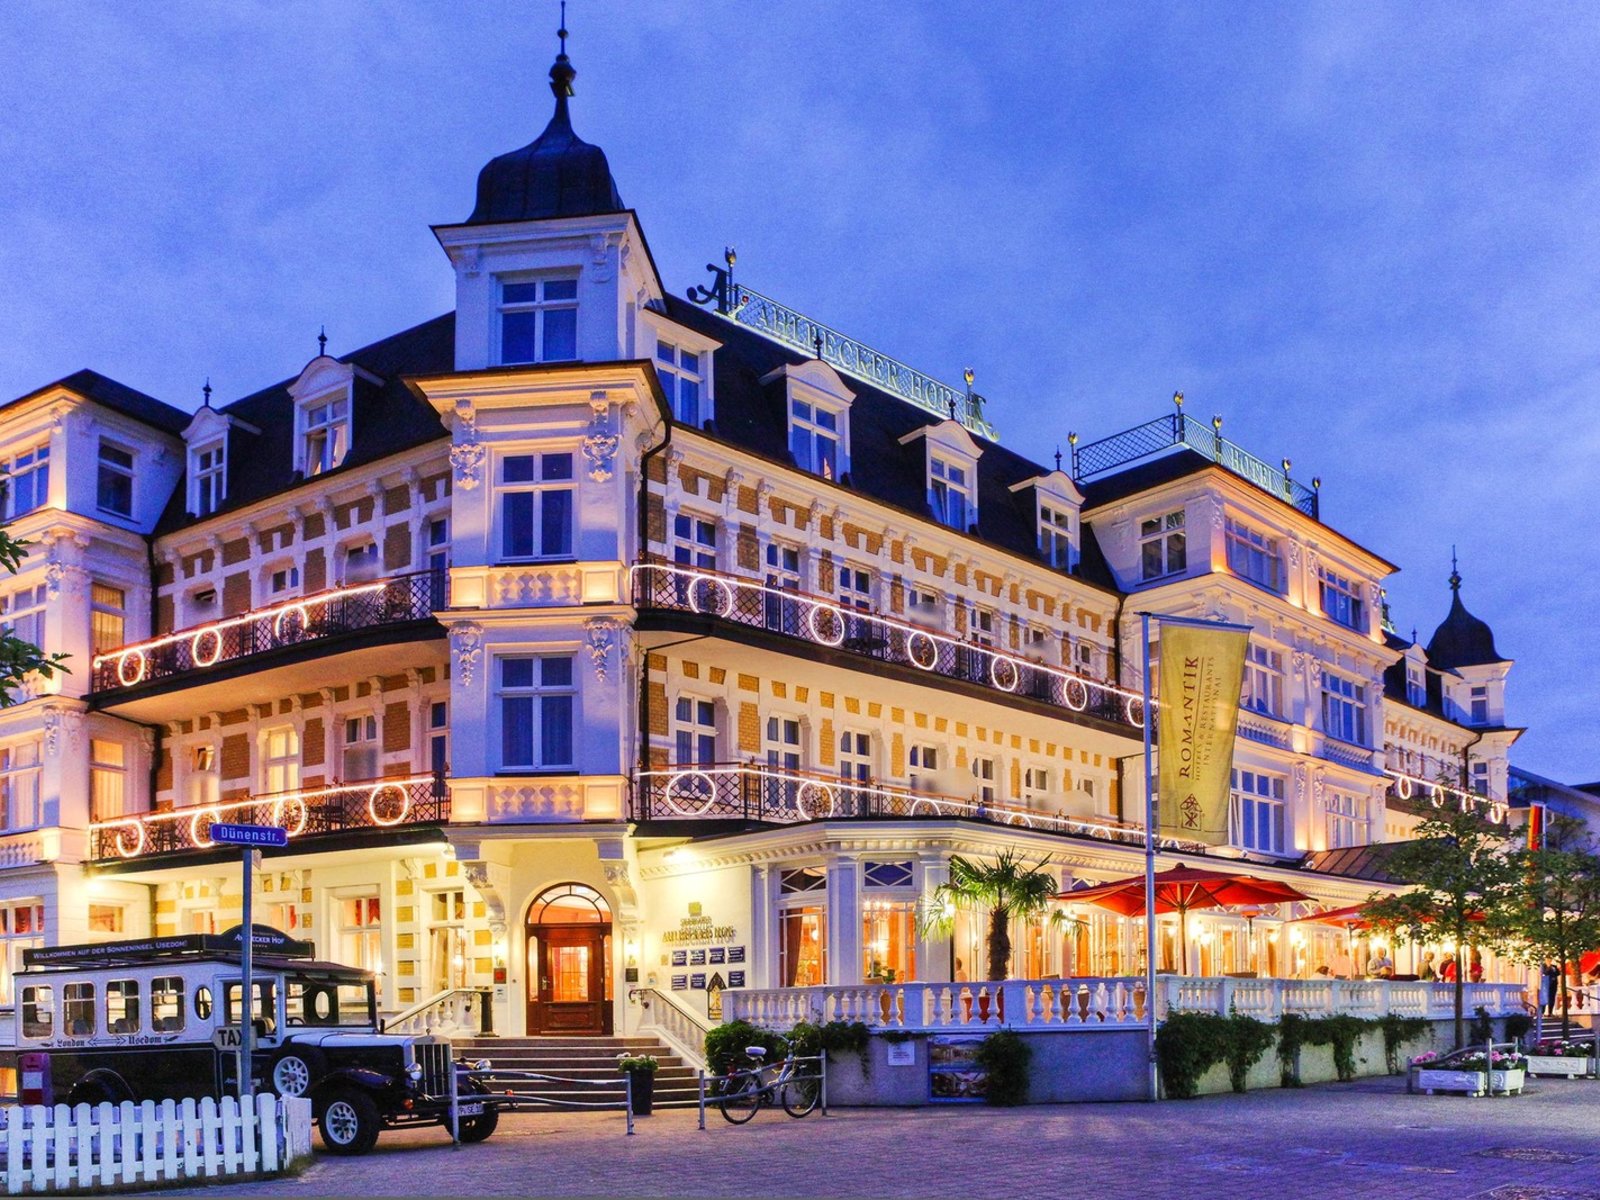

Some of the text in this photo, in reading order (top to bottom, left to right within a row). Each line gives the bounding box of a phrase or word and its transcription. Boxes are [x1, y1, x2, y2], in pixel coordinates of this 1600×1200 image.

[1199, 656, 1215, 730] RESTAURANTS
[1179, 656, 1200, 779] ROMANTIK
[221, 826, 280, 842] Dünenstr.
[33, 950, 76, 959] WILLKOMMEN
[106, 943, 154, 953] SONNENINSEL
[57, 1035, 161, 1047] London Usedom
[217, 1029, 243, 1046] TA
